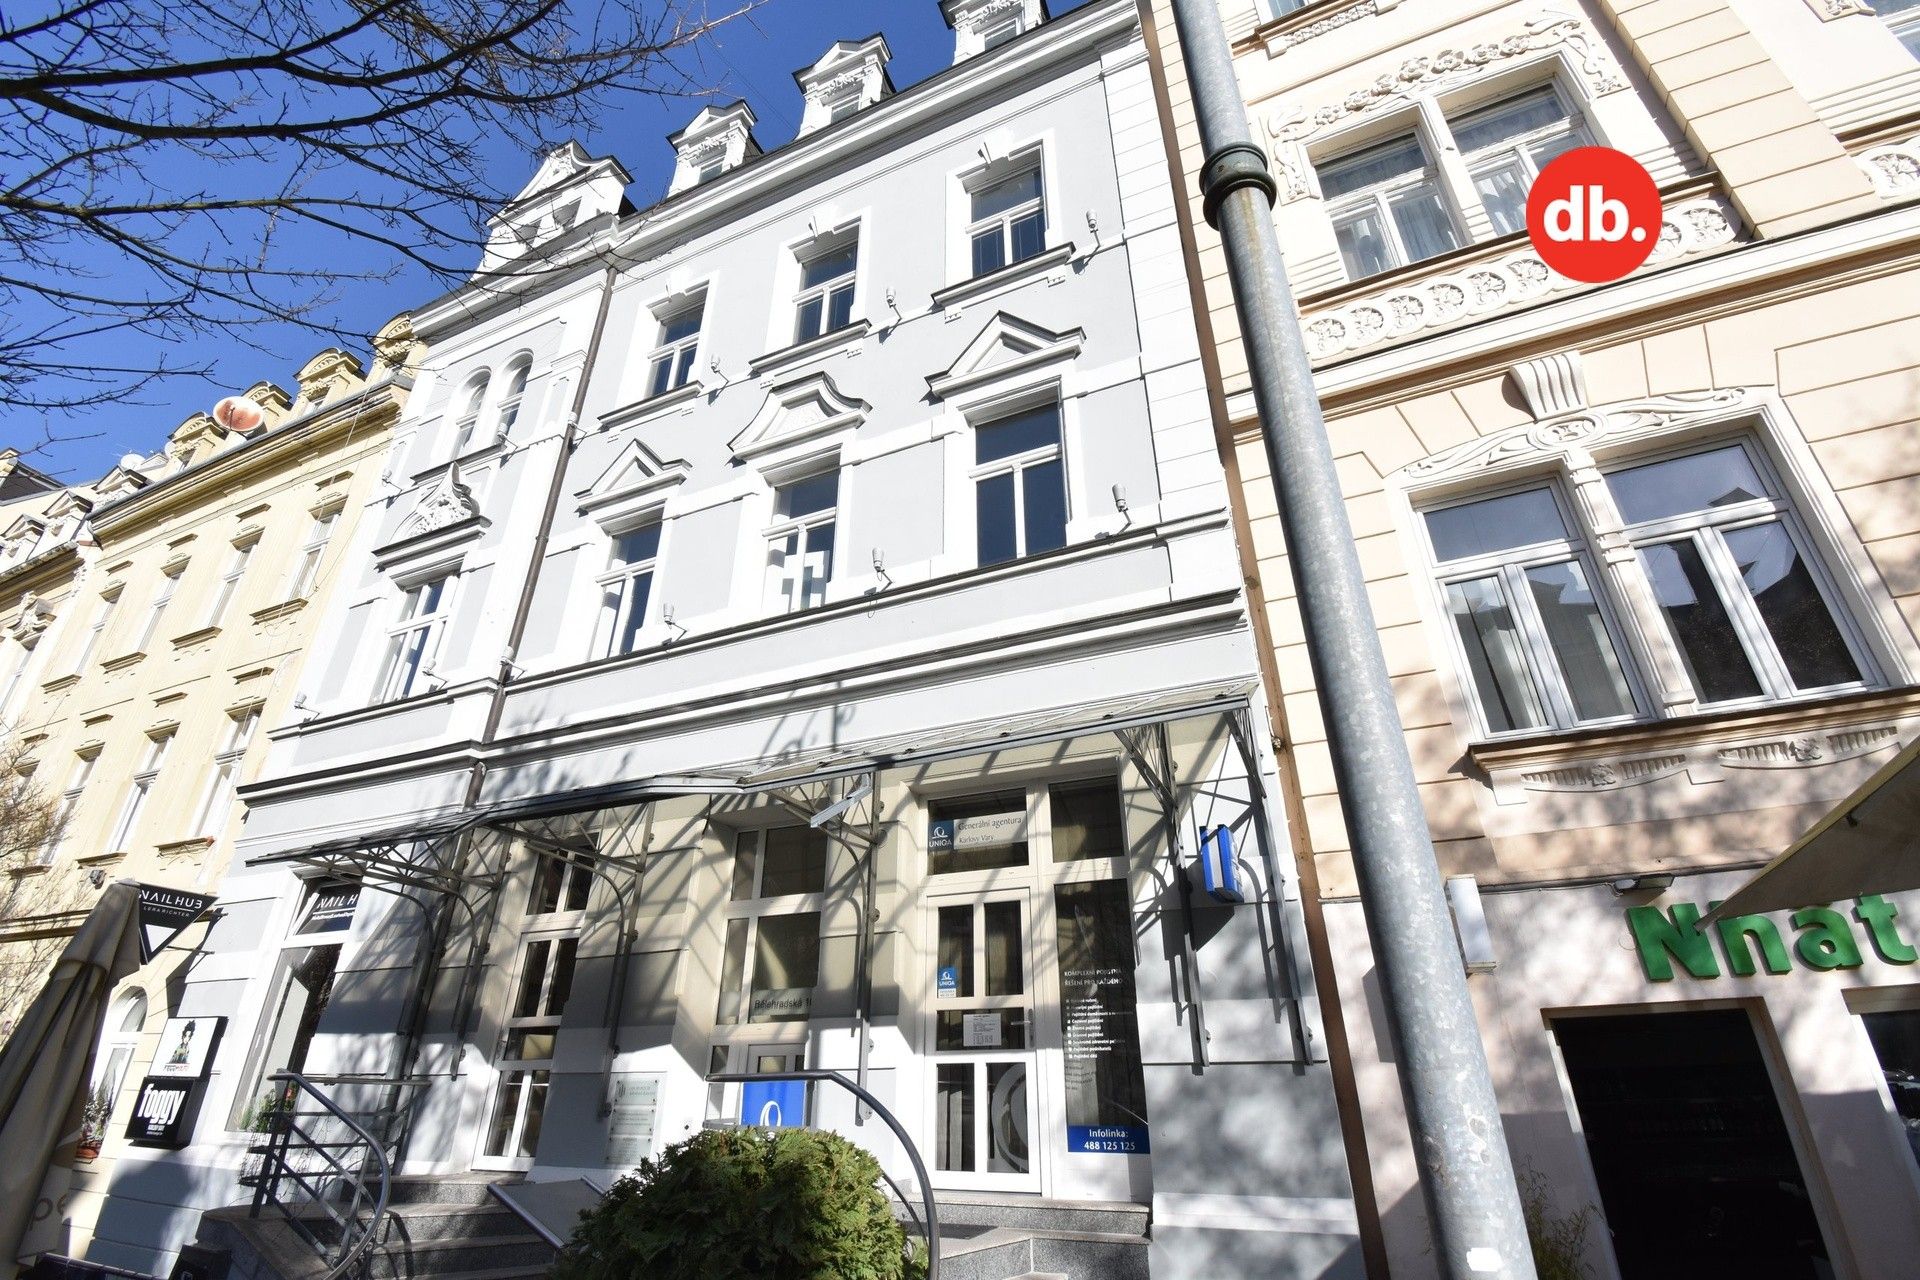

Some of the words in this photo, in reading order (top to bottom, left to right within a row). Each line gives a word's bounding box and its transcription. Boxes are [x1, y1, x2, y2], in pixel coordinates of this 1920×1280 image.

[991, 817, 1022, 829] agentura
[137, 1083, 186, 1125] foggy
[1089, 1128, 1129, 1138] Infolinka:
[1083, 1141, 1100, 1150] 488
[1103, 1141, 1118, 1150] 125
[1120, 1141, 1136, 1151] 125
